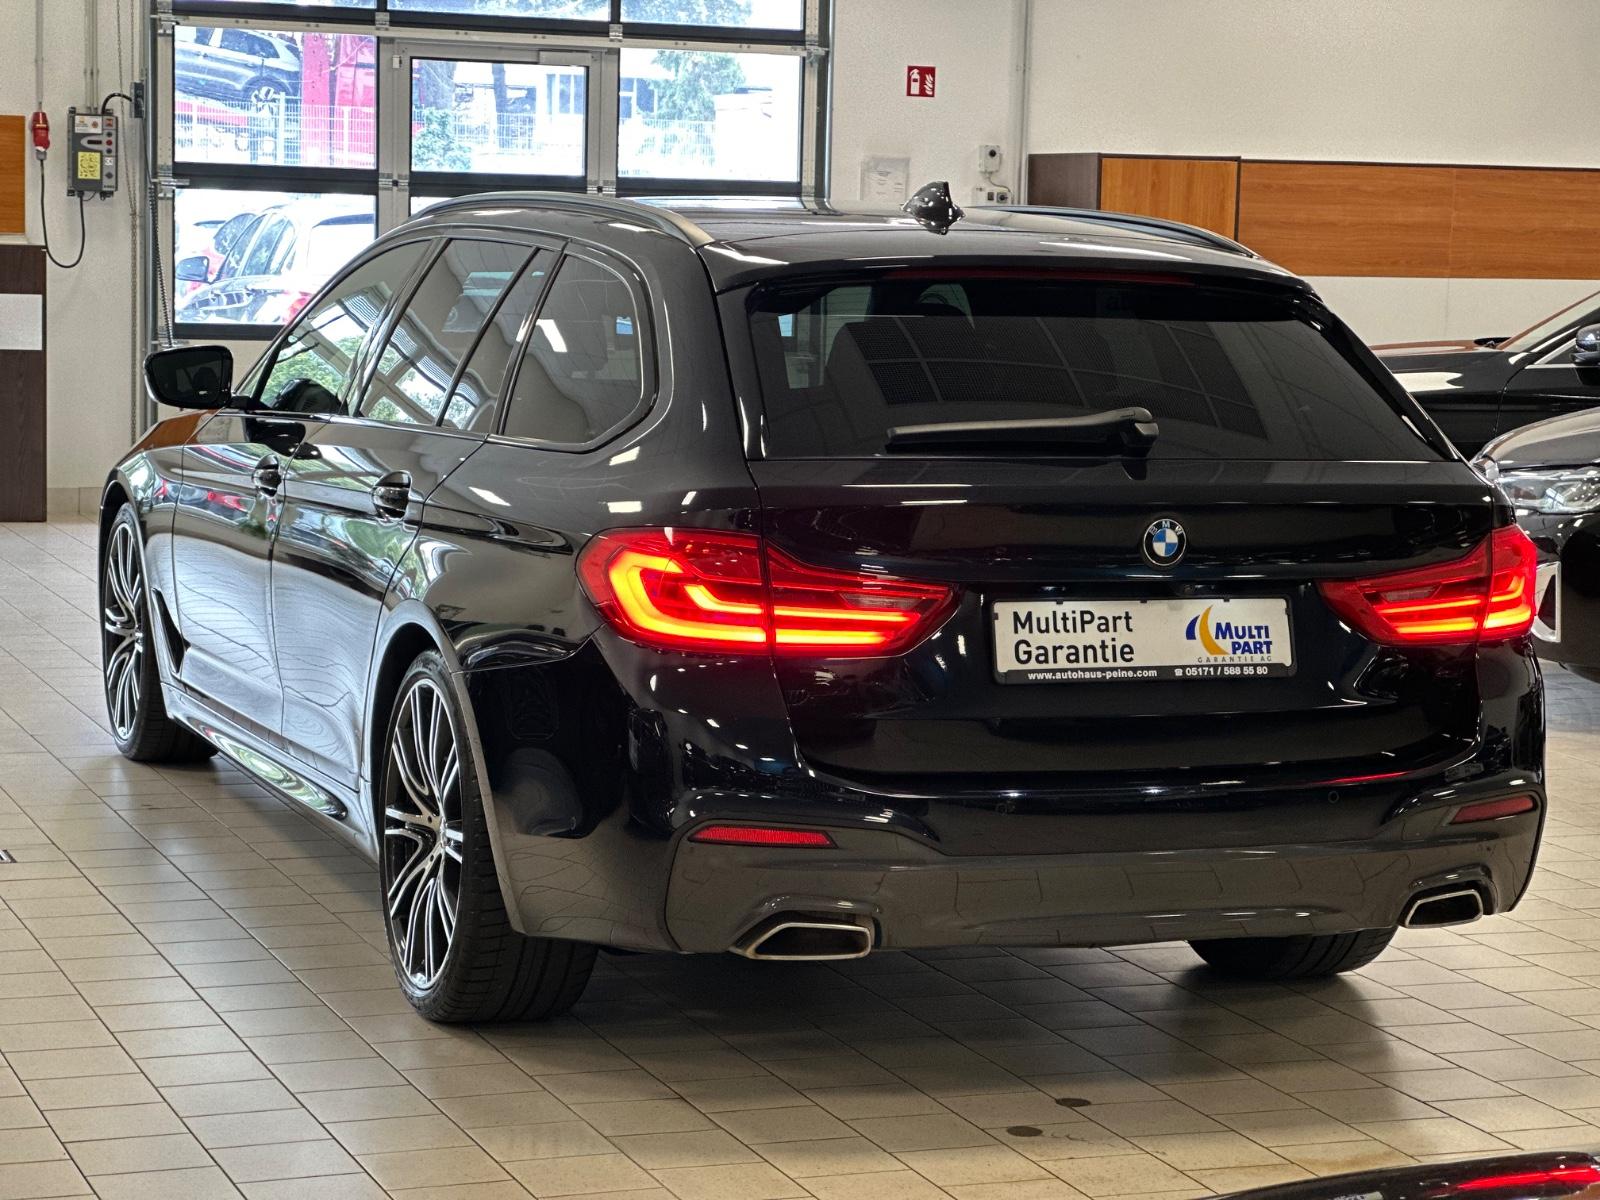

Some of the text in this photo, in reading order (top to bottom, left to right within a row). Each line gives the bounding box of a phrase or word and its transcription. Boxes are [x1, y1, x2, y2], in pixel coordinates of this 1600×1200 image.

[1149, 520, 1183, 535] BMW
[1013, 610, 1133, 634] MultiPart
[1215, 622, 1270, 639] MULTI
[1015, 638, 1134, 664] Garantie
[1232, 641, 1272, 654] PART
[1028, 669, 1157, 680] www.autohaus-peine.com
[1185, 667, 1215, 676] 05171
[1223, 666, 1241, 675] 588
[1243, 666, 1255, 675] 55
[1256, 666, 1268, 674] 80
